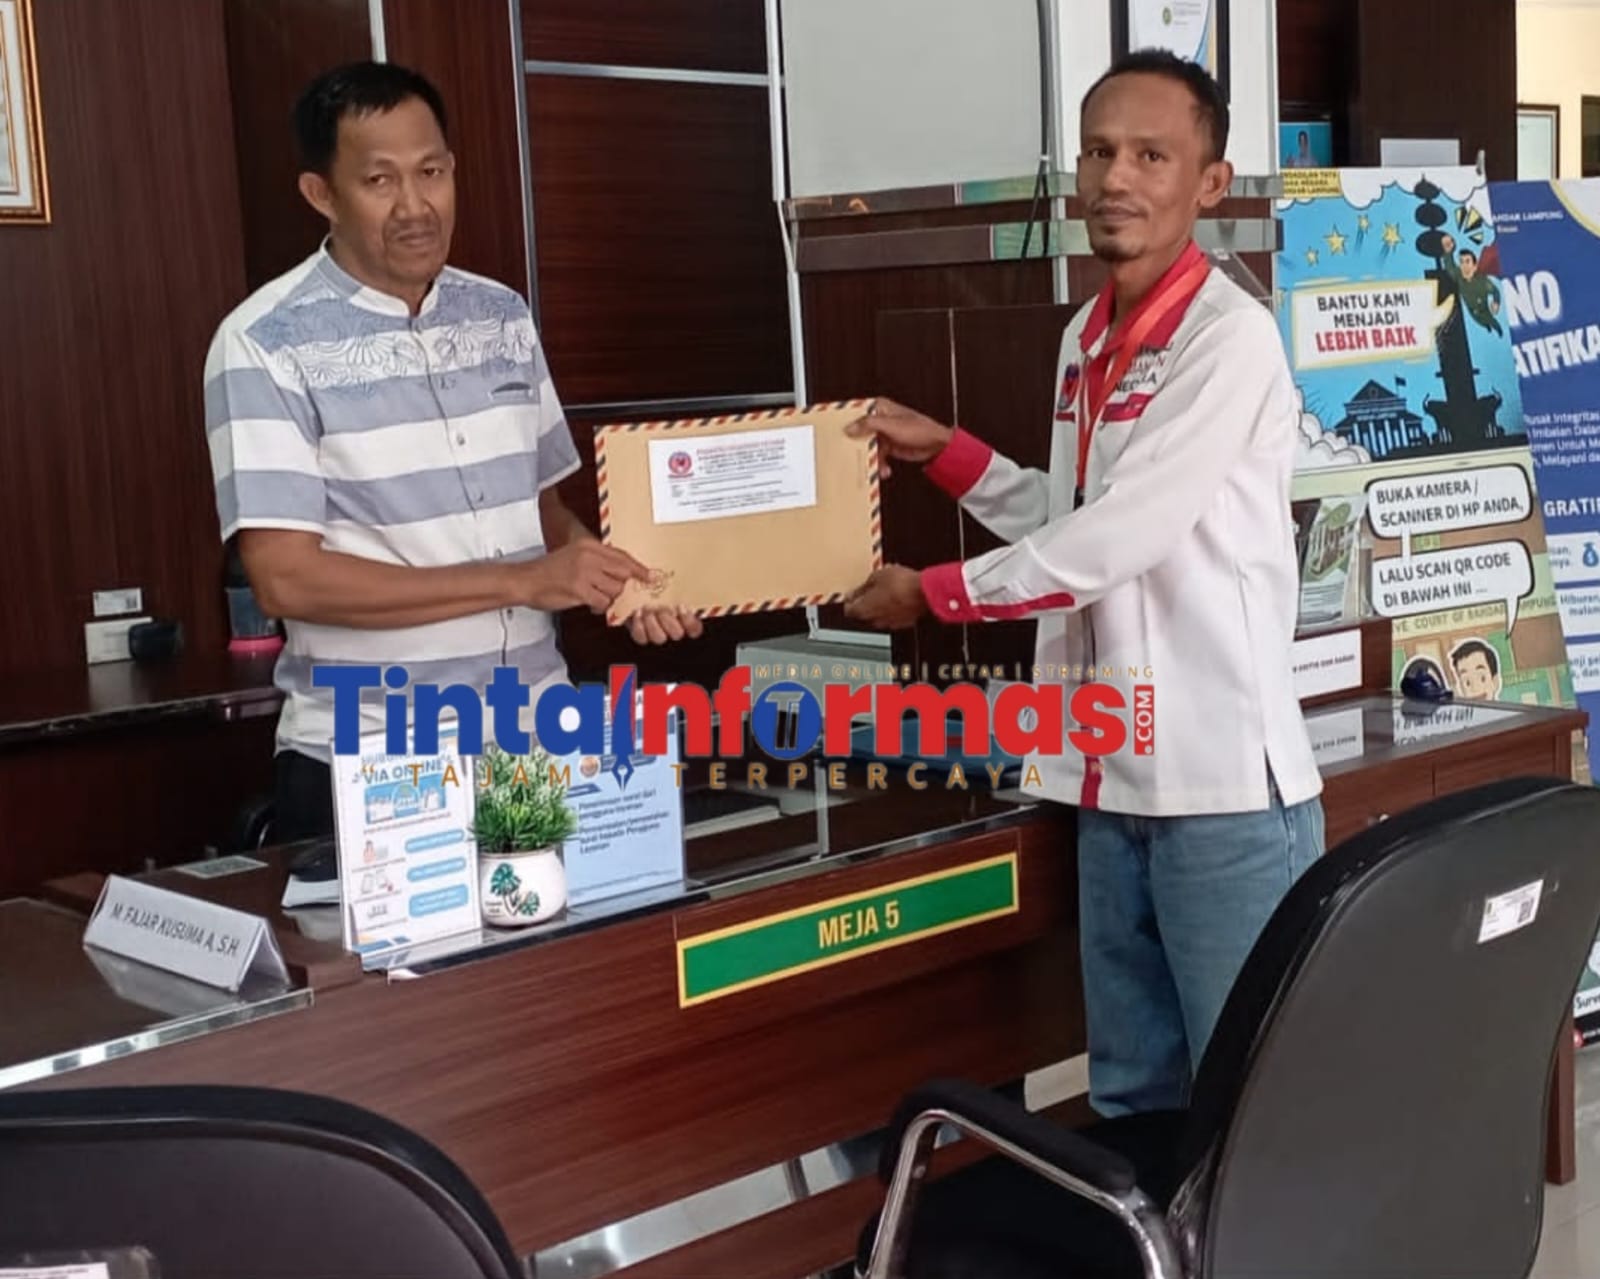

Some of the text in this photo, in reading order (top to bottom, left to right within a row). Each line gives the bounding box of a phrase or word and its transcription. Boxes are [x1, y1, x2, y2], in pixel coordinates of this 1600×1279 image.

[1317, 290, 1410, 312] BANTU KAMI
[1501, 268, 1561, 328] NO
[1333, 310, 1400, 329] MENJADI
[1315, 325, 1417, 354] LEBIH BAIK
[1376, 486, 1414, 505] BUKA
[1416, 479, 1472, 497] KAMERA
[1380, 496, 1524, 528] SCANNER DI HP ANDA,
[1379, 552, 1512, 585] LALU SCAN QR CODE
[1383, 593, 1398, 608] DI
[1401, 585, 1451, 606] BAWAH
[1453, 581, 1473, 596] INI
[363, 767, 389, 785] VIA
[124, 907, 160, 931] FAJAR
[156, 917, 205, 945] KUSUMA
[818, 899, 900, 949] MEJA 5
